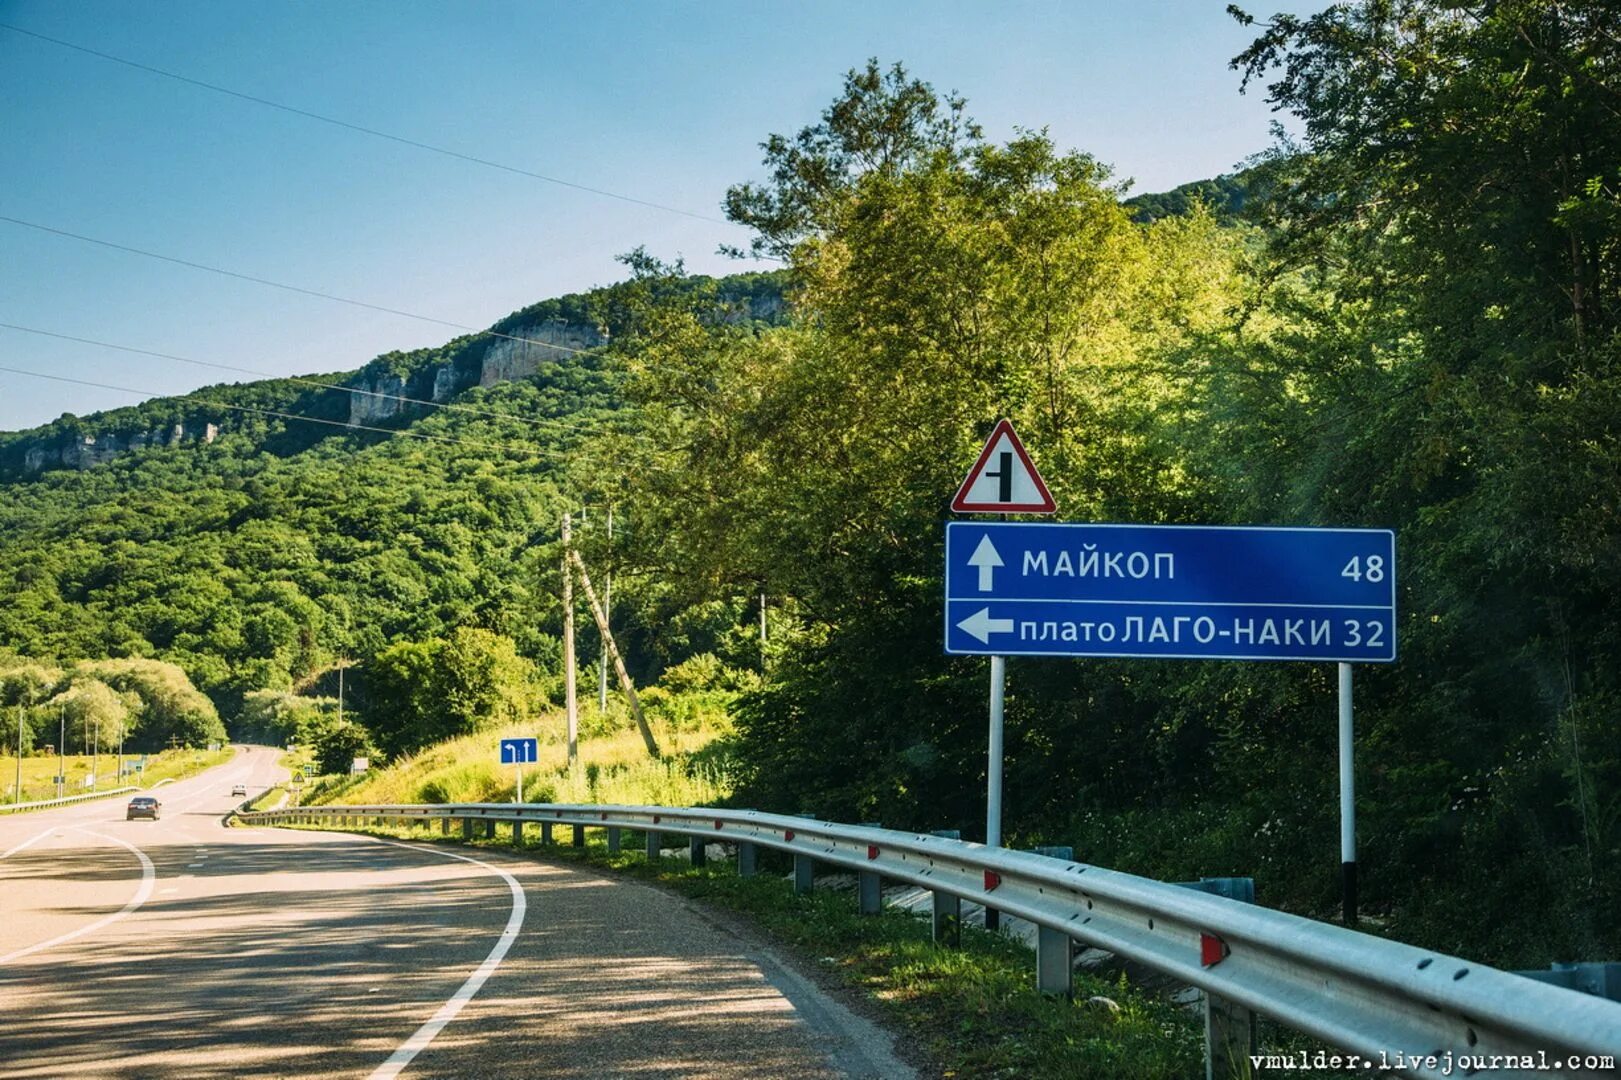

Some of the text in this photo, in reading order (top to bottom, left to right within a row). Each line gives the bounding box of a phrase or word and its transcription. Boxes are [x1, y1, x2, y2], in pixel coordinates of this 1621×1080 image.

[1022, 543, 1384, 583] МАЙКОП 48
[1020, 616, 1384, 647] плато ЛАГО-НАКИ 32
